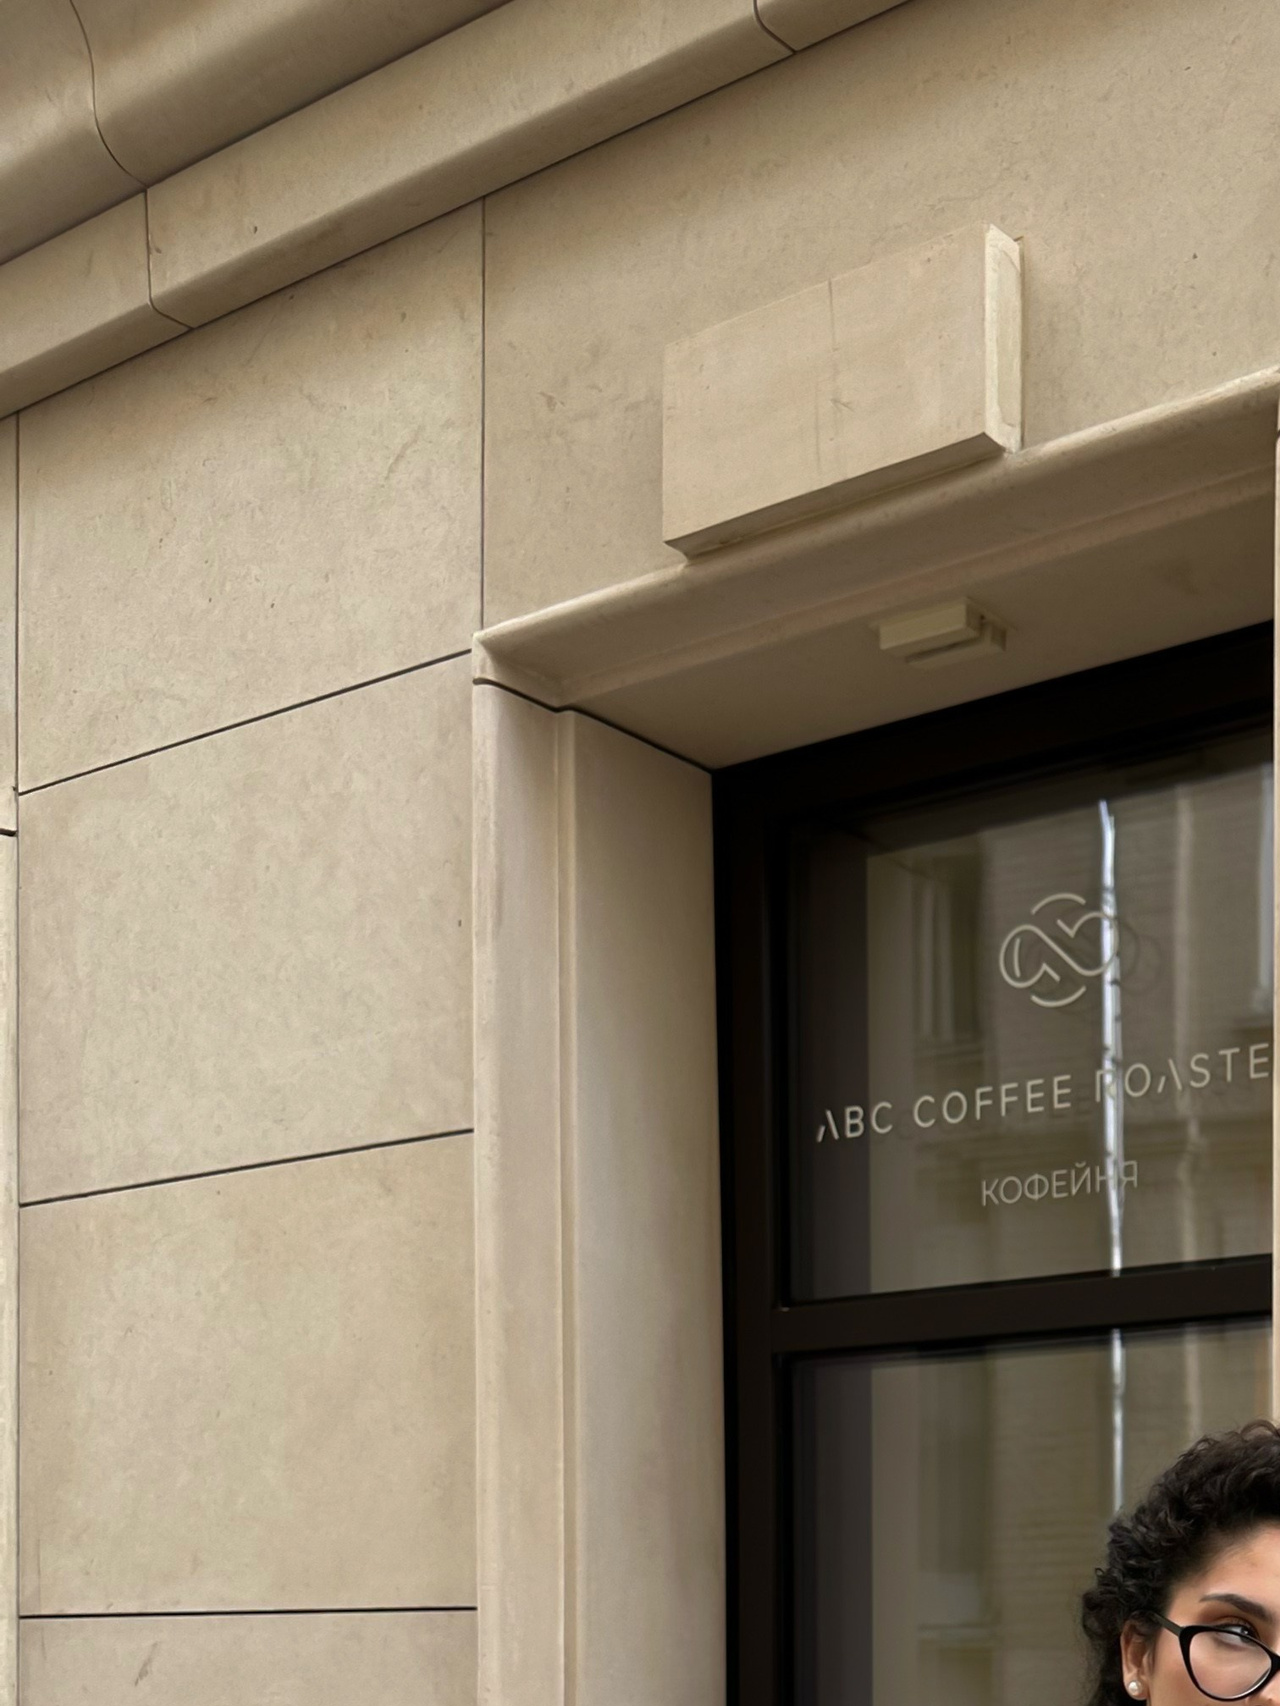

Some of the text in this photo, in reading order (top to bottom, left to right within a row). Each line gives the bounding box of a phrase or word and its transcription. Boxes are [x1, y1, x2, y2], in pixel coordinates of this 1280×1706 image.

[816, 1043, 1269, 1143] ABC COFFEE ROASTE
[981, 1160, 1138, 1207] КОФЕЙНЯ
